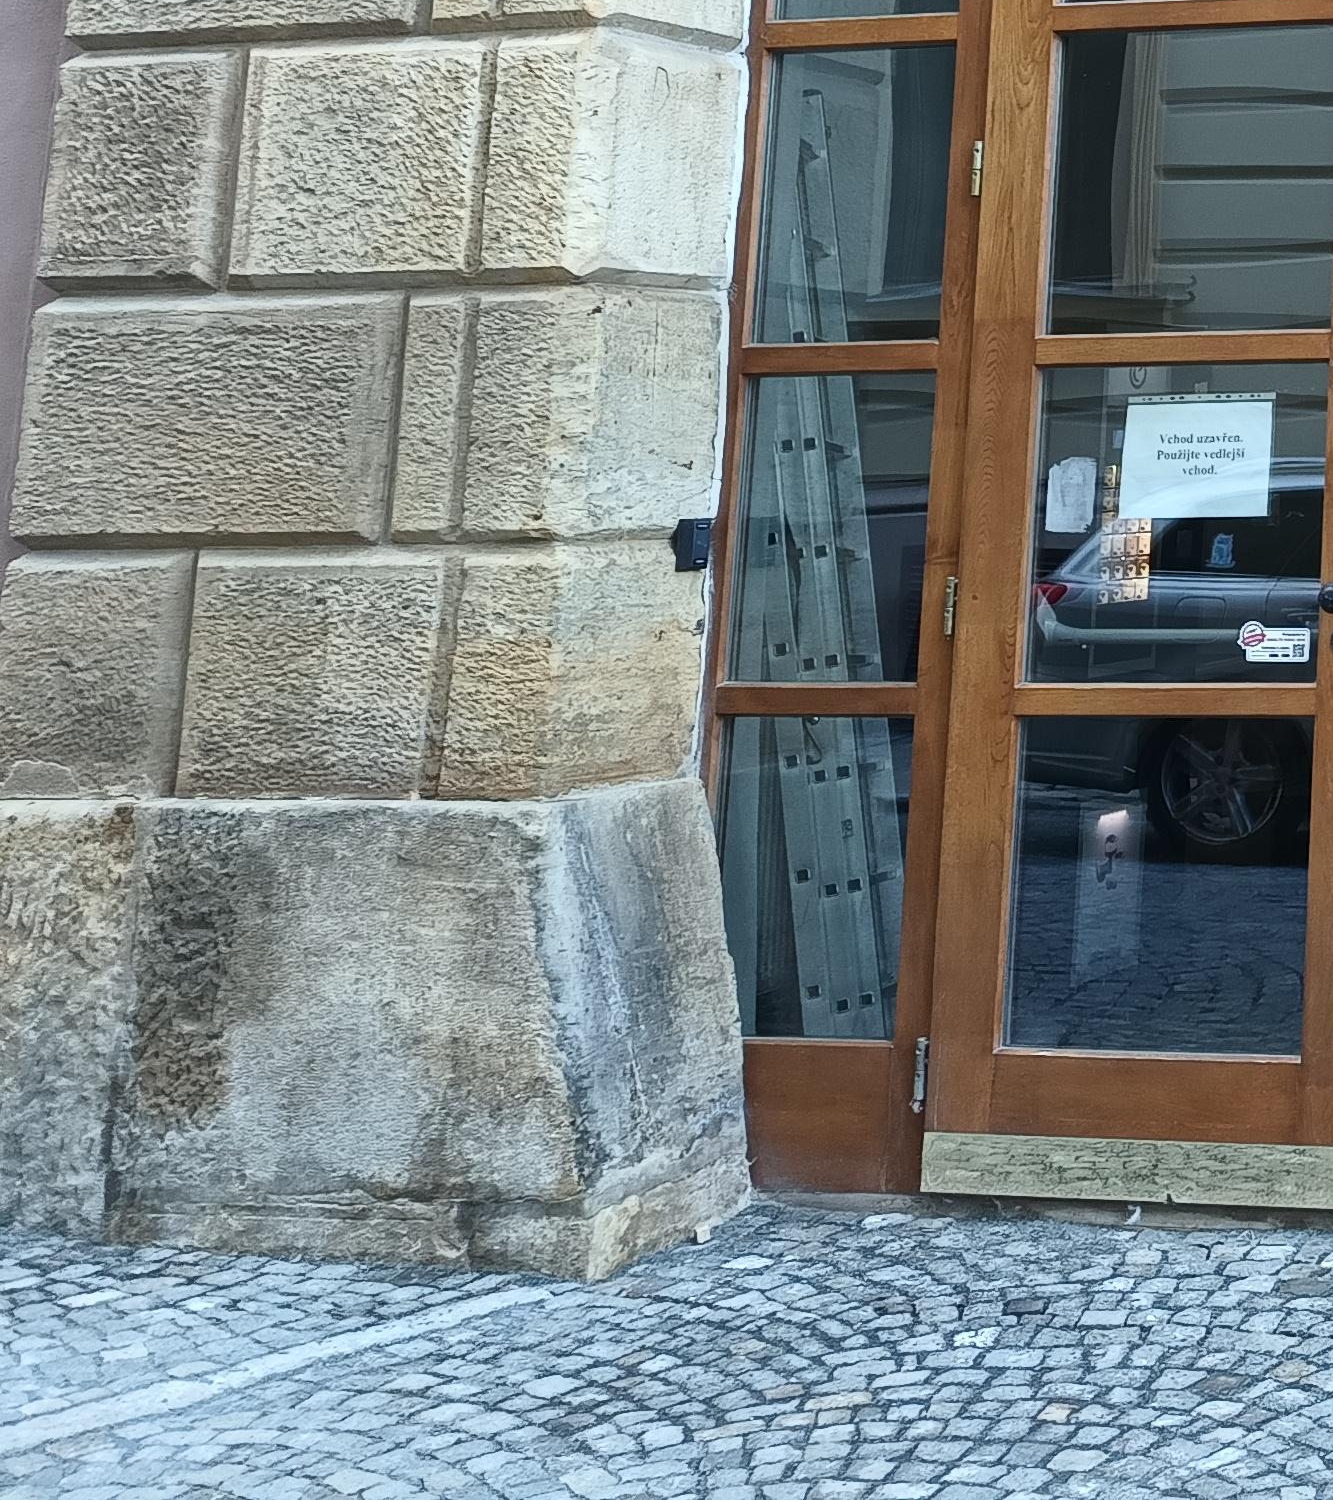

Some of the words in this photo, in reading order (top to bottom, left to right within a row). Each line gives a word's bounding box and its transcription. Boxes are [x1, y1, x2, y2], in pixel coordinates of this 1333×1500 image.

[1159, 433, 1194, 444] Vchod
[1196, 432, 1244, 443] uzavřen.
[1157, 448, 1201, 462] Použijte
[1203, 448, 1245, 461] vedlejší
[1182, 464, 1218, 476] vchod.
